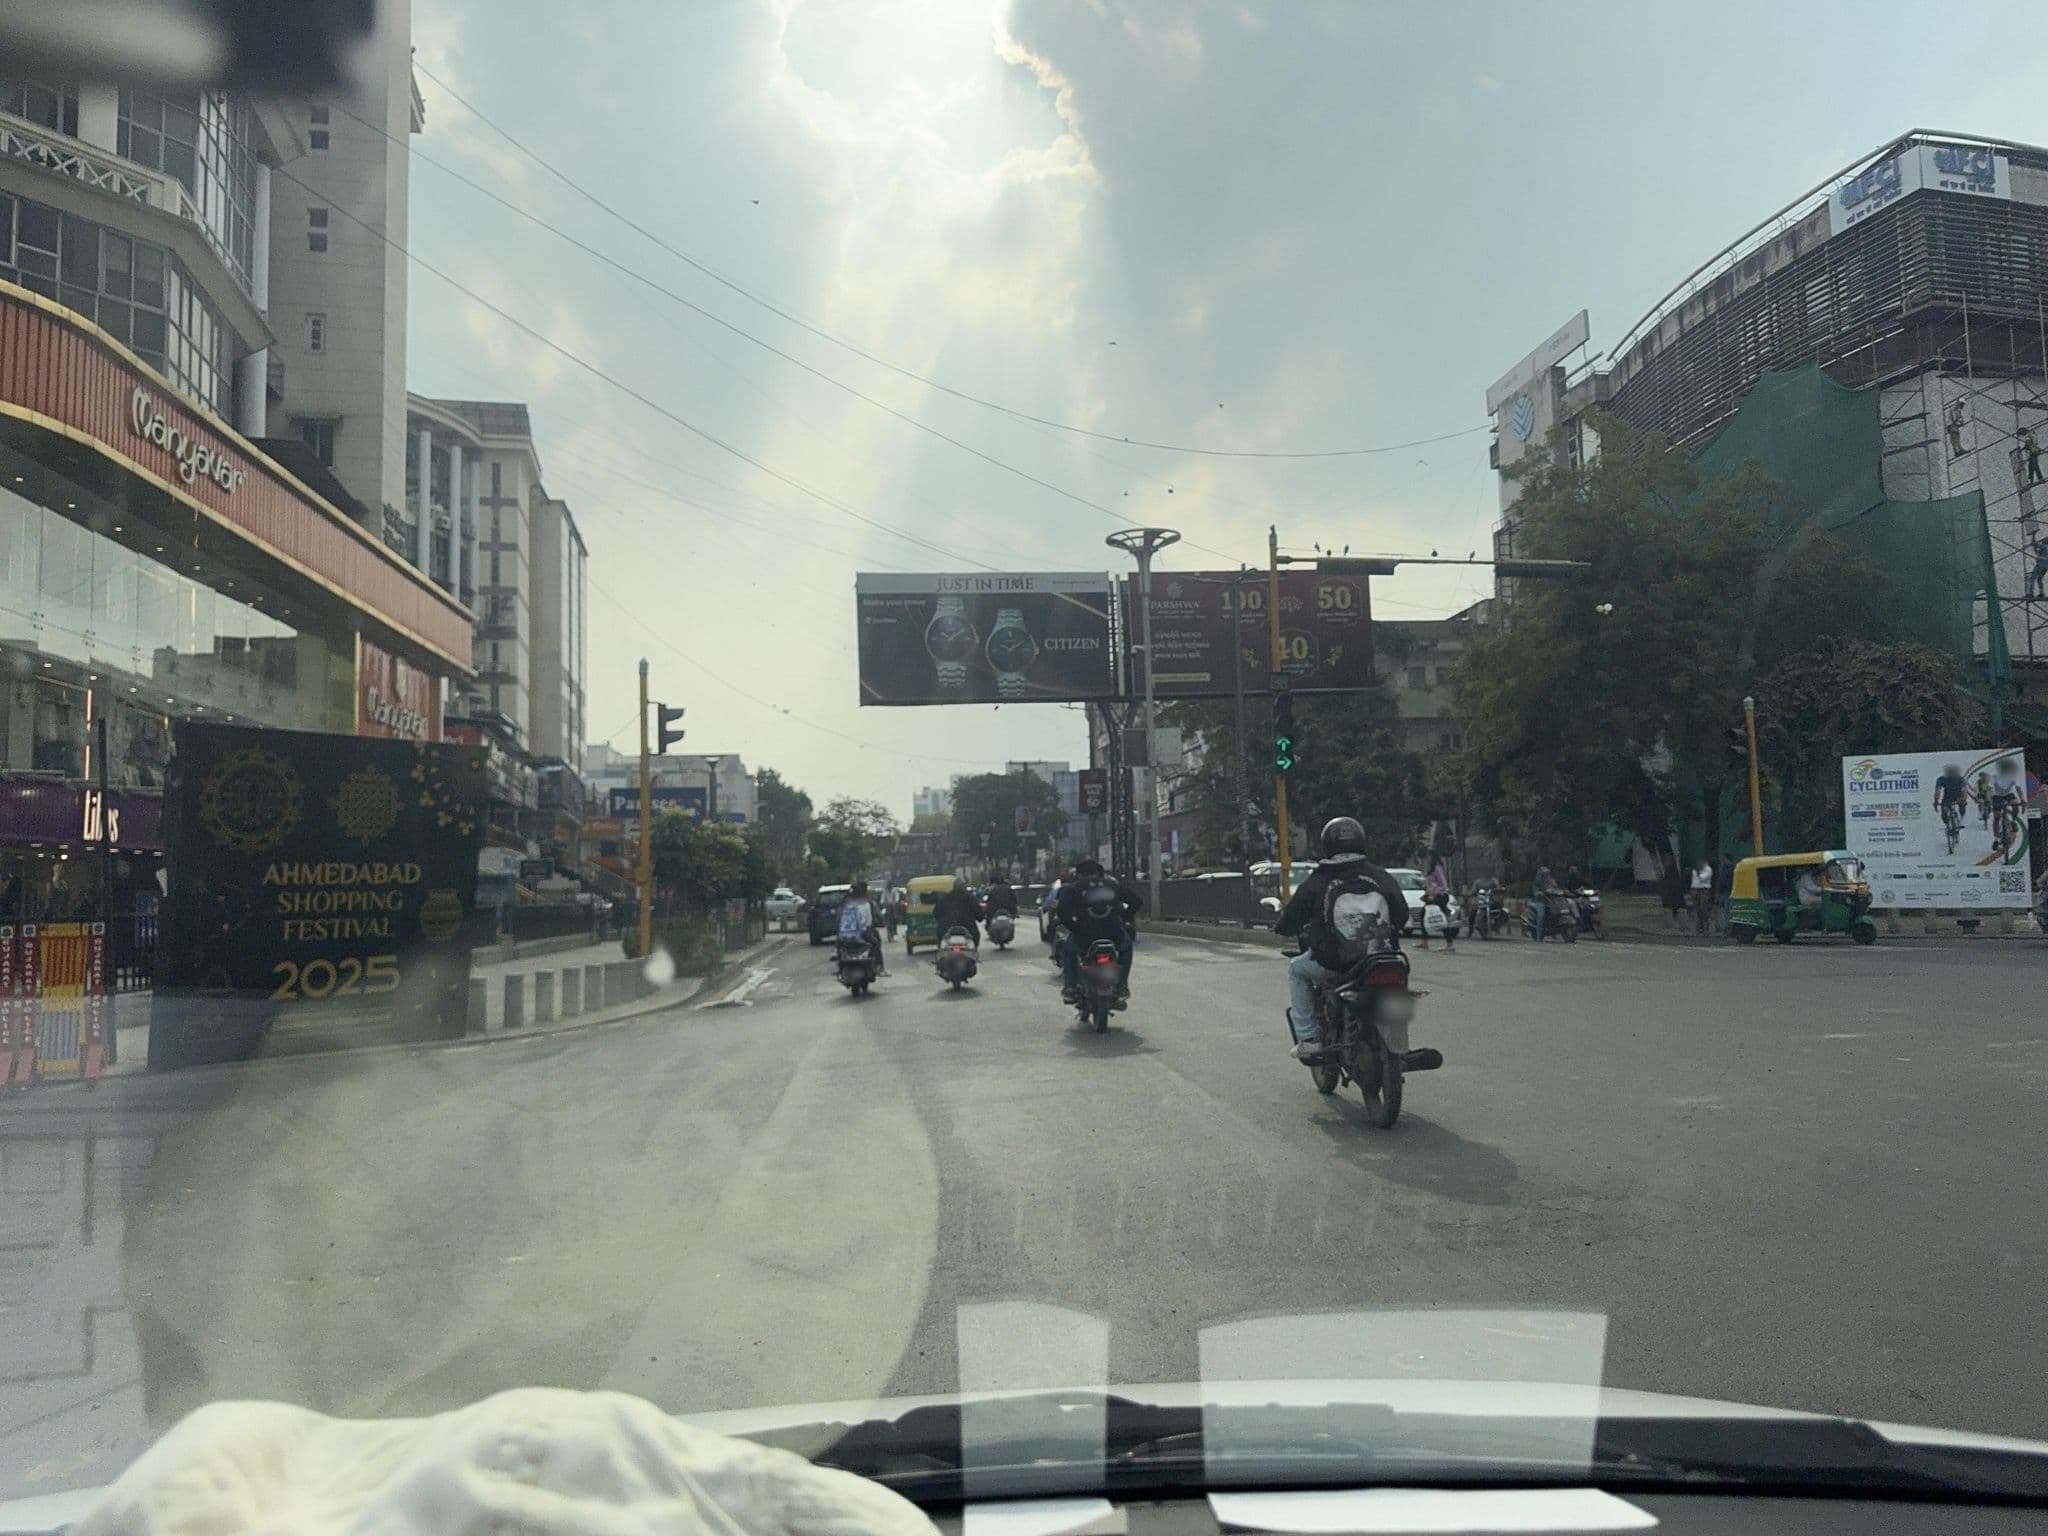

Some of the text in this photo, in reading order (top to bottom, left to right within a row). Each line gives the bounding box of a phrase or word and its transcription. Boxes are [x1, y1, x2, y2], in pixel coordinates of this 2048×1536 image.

[131, 386, 245, 493] Manyavar
[936, 577, 1034, 592] JUST IN TIME
[1150, 600, 1201, 609] PARSHWA
[1318, 585, 1352, 609] 50
[1044, 637, 1100, 651] CITIZEN
[1849, 778, 1919, 792] CYCLOTHON
[262, 861, 422, 888] AHMEDABAD
[277, 890, 403, 913] SHOPPING
[282, 917, 394, 942] FESTIVAL
[270, 954, 401, 1002] 2025
